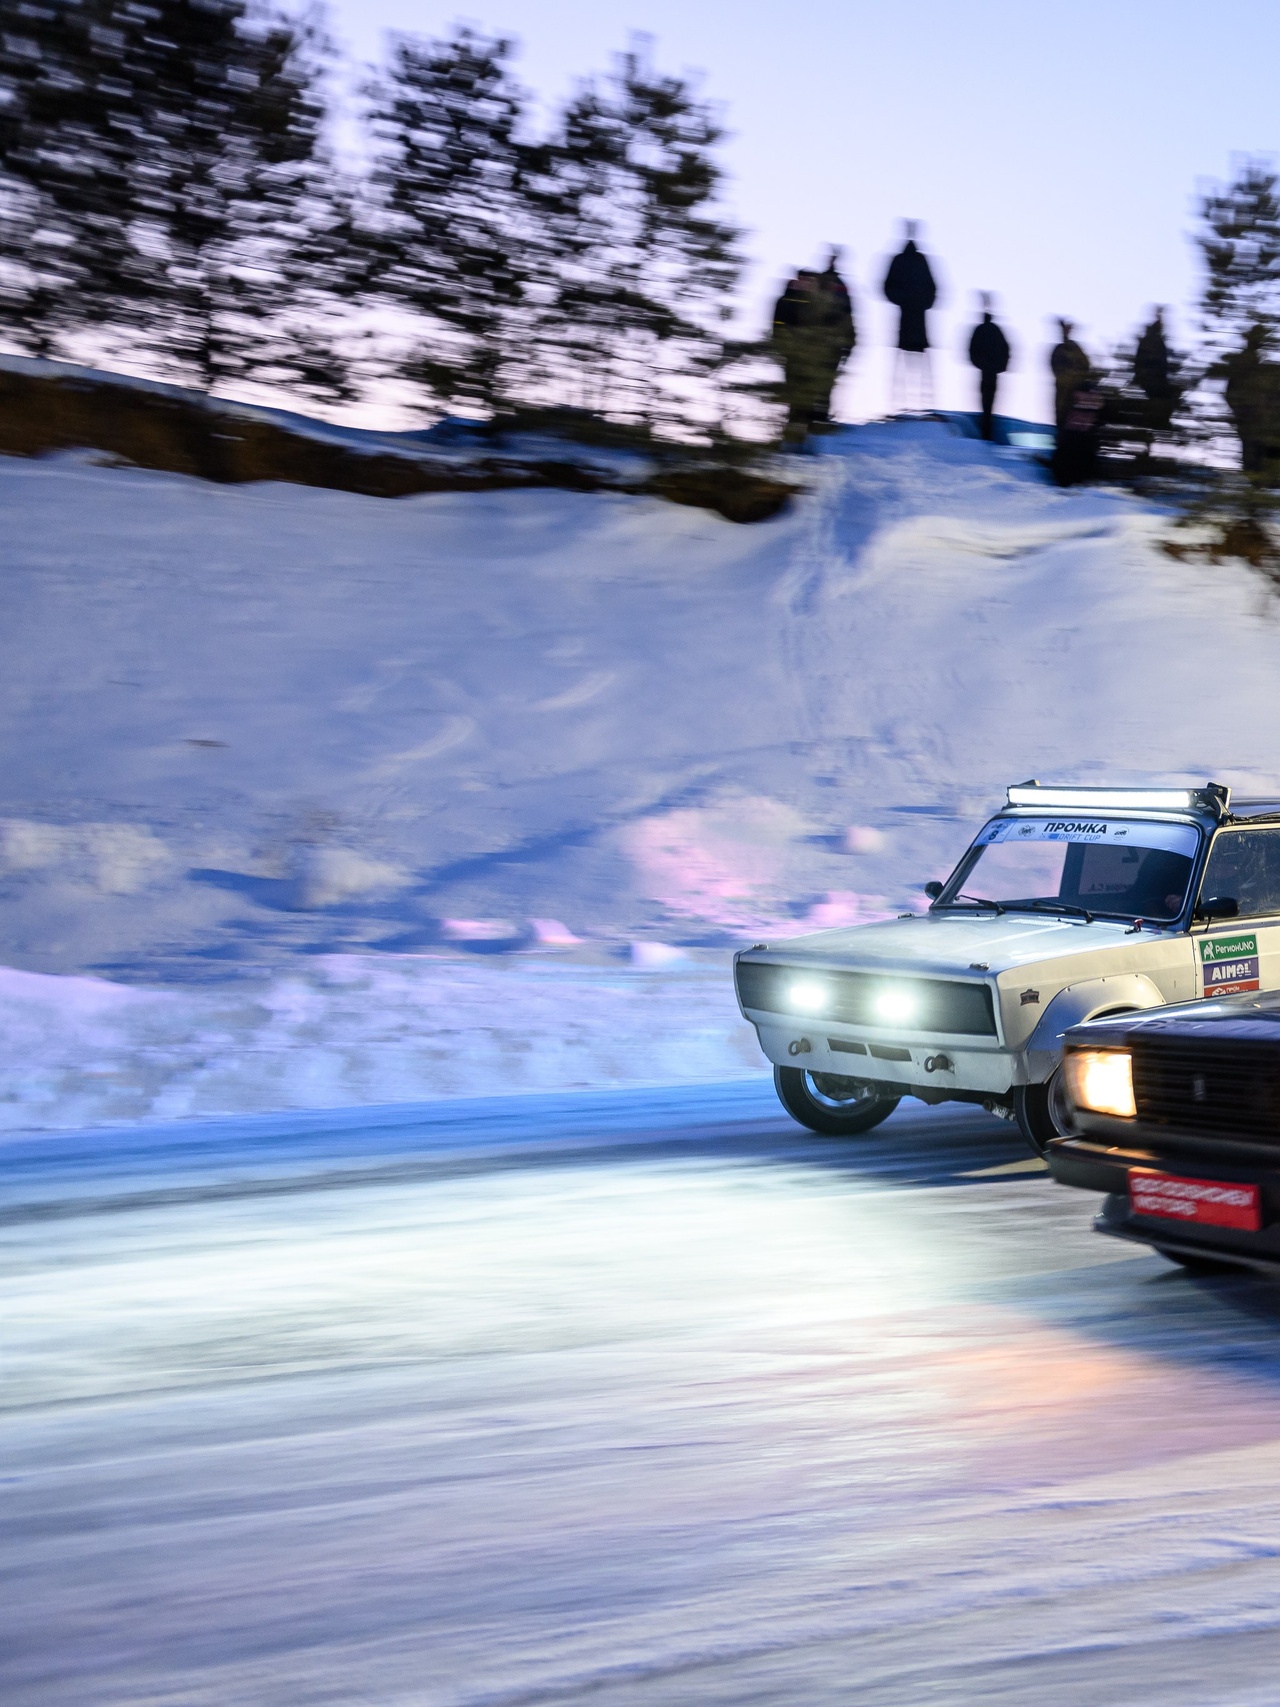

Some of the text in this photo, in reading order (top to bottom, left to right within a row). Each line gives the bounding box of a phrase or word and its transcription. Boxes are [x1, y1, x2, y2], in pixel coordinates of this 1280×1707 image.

[1044, 822, 1107, 834] ПРОМКА
[1058, 833, 1101, 842] DRIFT CUP
